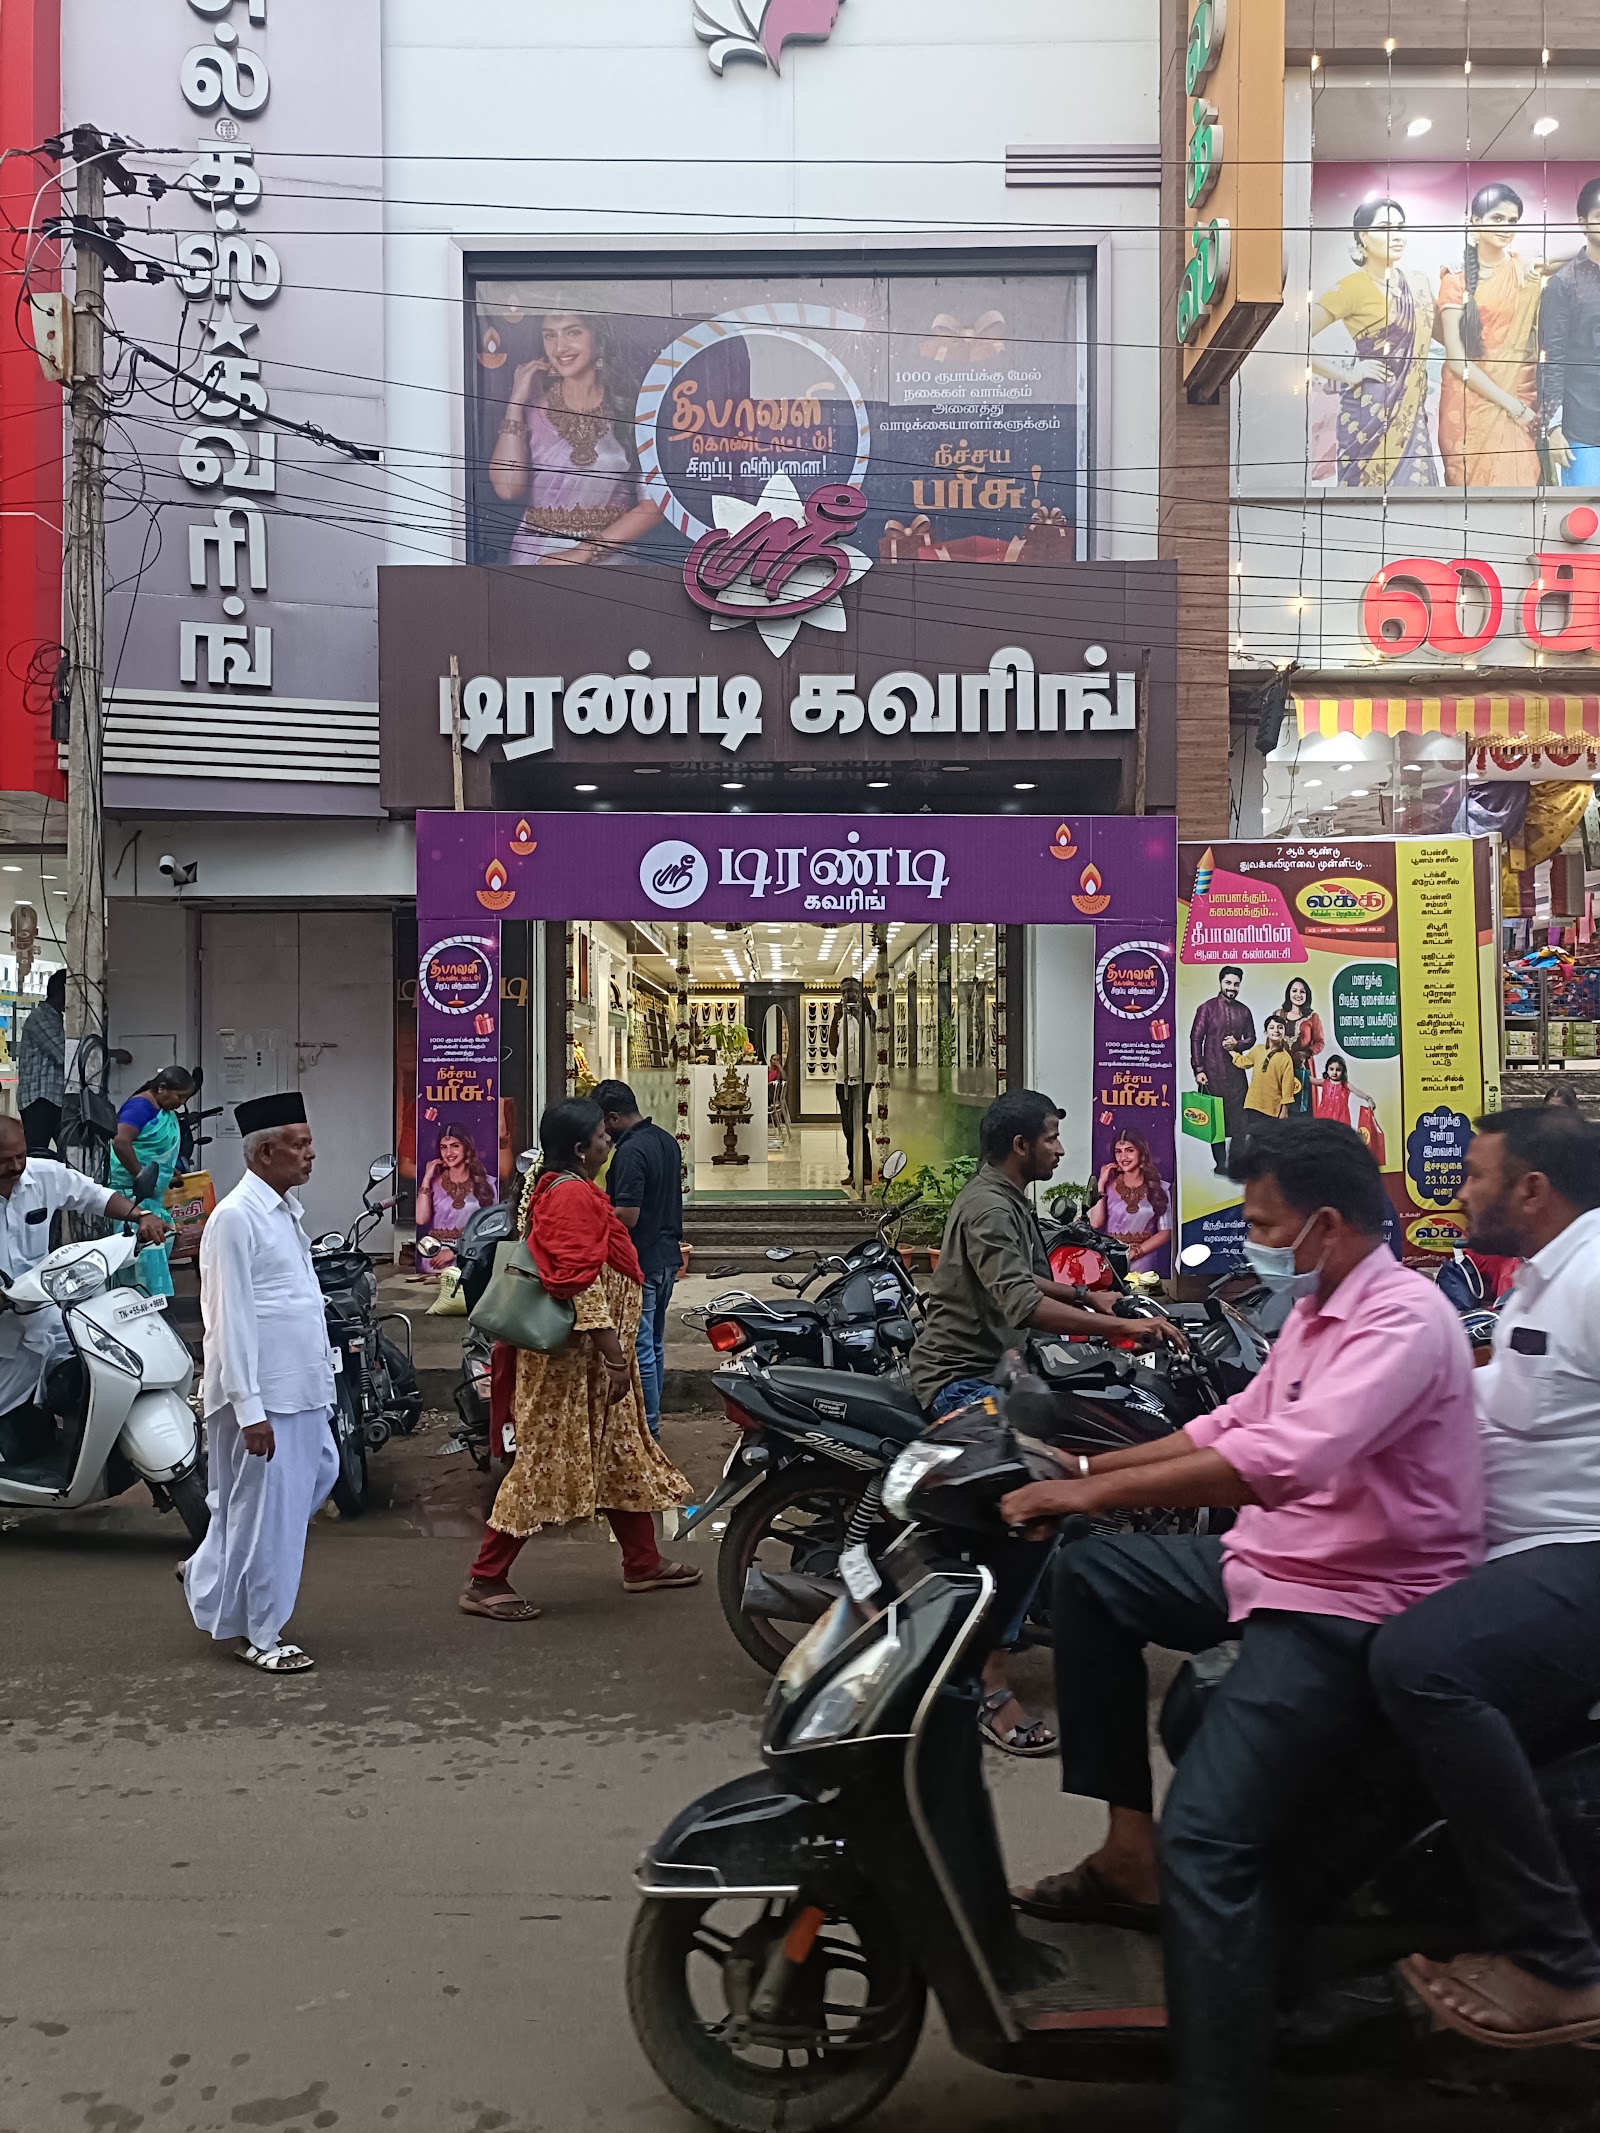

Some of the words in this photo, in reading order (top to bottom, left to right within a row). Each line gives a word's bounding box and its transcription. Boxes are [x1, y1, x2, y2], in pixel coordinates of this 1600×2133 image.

[895, 371, 931, 383] 1000
[935, 369, 1004, 385] ரூபாய்க்கு
[1007, 368, 1042, 382] மேல்
[904, 385, 966, 401] நகைகள்
[970, 384, 1033, 398] வாங்கும்
[668, 380, 835, 441] தீபாவளி
[932, 401, 1005, 417] அனைத்து
[934, 439, 1011, 467] நிச்சய
[686, 456, 733, 481] சிறப்பு
[440, 649, 763, 761] டிரண்டி
[790, 645, 1136, 735] கவரிங்
[1277, 847, 1282, 855] 7
[1286, 847, 1304, 858] ஆம்
[1307, 847, 1340, 858] ஆண்டு
[718, 831, 950, 899] டிரண்டி
[804, 888, 886, 913] கவரிங்
[1191, 921, 1292, 947] தீபாவளியின்
[429, 959, 482, 978] தீபாவளி
[1106, 963, 1158, 982] தீபாவளி
[437, 1065, 476, 1080] நிச்சய
[1113, 1070, 1152, 1085] நிச்சய
[1430, 1129, 1455, 1144] ஒன்று
[1425, 1175, 1462, 1185] 23.10.23
[1433, 1188, 1453, 1197] வரை
[171, 1201, 203, 1219] க்தி
[1124, 1400, 1171, 1423] HONDA
[794, 1432, 869, 1456] Shine
